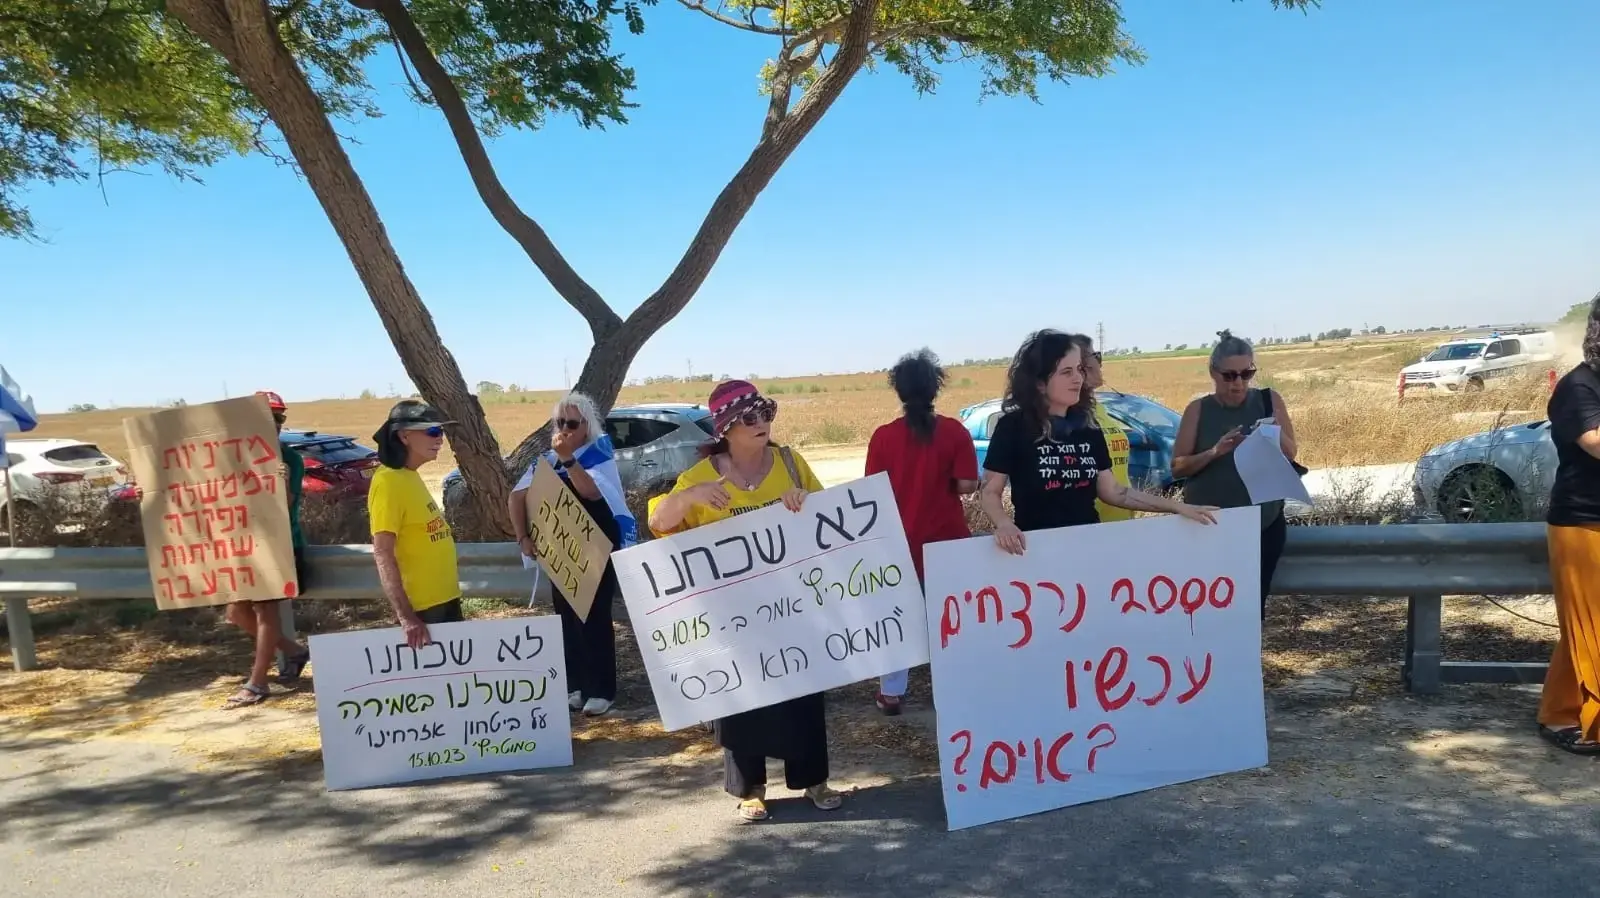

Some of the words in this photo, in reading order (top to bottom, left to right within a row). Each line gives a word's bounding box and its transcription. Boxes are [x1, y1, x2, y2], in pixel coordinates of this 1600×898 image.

[163, 435, 277, 470] מדיניות
[1039, 456, 1060, 465] הוא
[1057, 444, 1076, 453] הוא
[1080, 456, 1097, 465] הוא
[168, 470, 277, 508] הממשלה
[1039, 467, 1056, 479] ילד
[1061, 469, 1080, 479] הוא
[164, 505, 248, 542] הפקרה
[555, 487, 594, 542] איראן
[816, 488, 877, 550] לא
[161, 535, 254, 569] שחיתות
[539, 500, 589, 574] נשארה
[527, 521, 580, 599] גרעינים
[641, 524, 787, 599] שכחנו
[757, 598, 802, 621] אמר
[1111, 575, 1235, 615] 2000
[652, 611, 711, 652] 9.10.15
[940, 580, 1087, 649] נרצחים
[364, 638, 473, 675] שכחנו
[497, 625, 544, 663] לא
[760, 646, 809, 682] הוא
[1065, 646, 1213, 713] עכשיו
[337, 693, 435, 720] בשמירה
[531, 707, 548, 730] על
[464, 711, 521, 745] ביטחון
[408, 748, 466, 769] 15.10.23
[949, 723, 1117, 793] באים?
